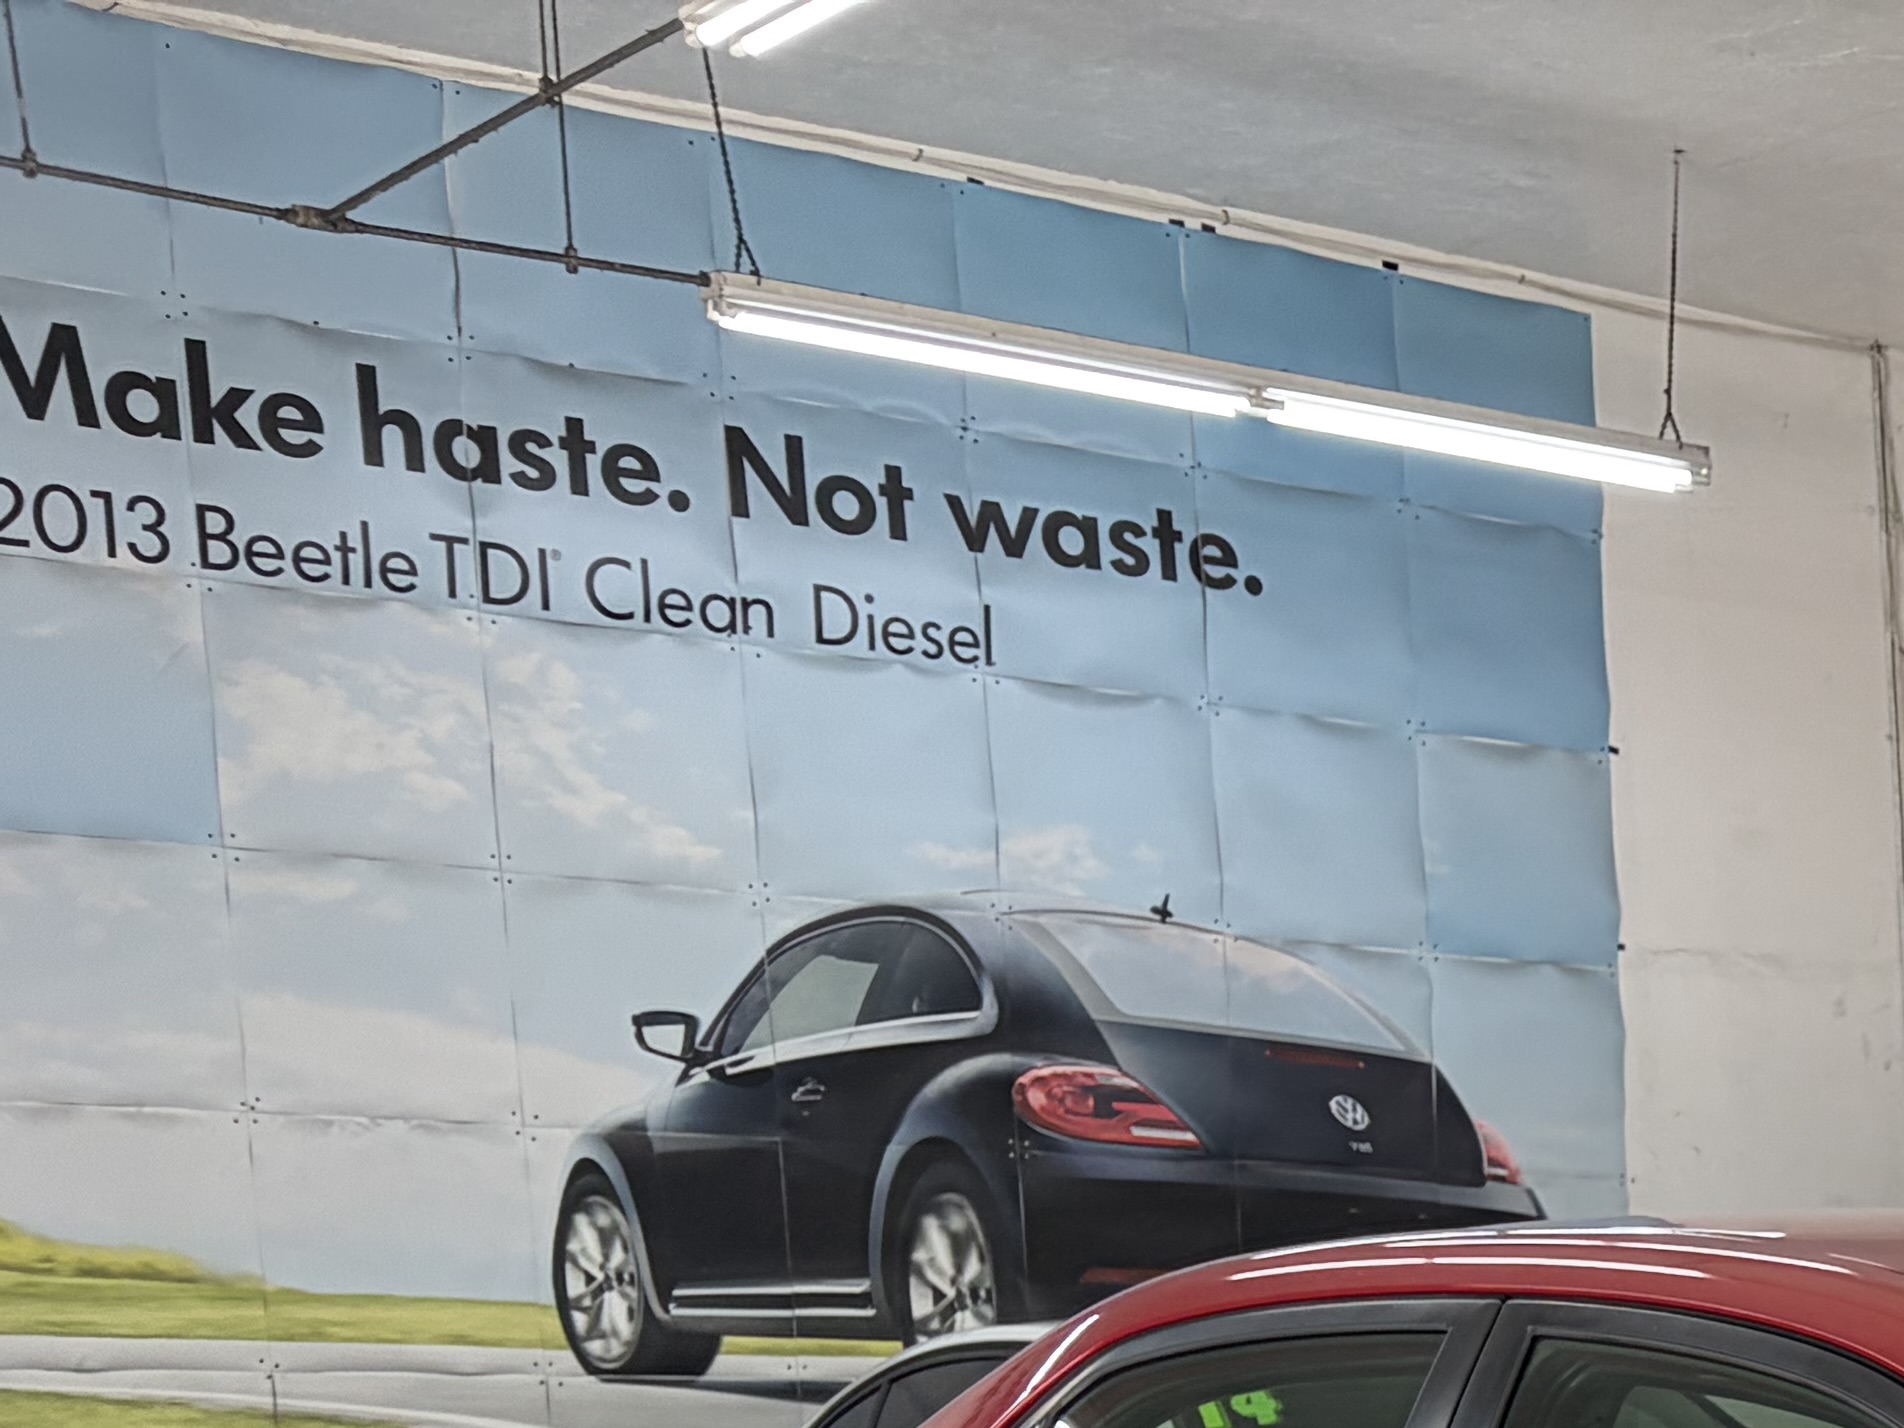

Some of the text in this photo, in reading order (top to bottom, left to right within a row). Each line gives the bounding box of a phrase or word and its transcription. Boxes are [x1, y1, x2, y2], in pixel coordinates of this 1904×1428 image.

[0, 314, 1264, 597] Make haste. Not waste.
[0, 477, 170, 565] 2013
[195, 503, 419, 594] Beetle
[585, 556, 775, 638] Clean
[813, 583, 996, 666] Diesel
